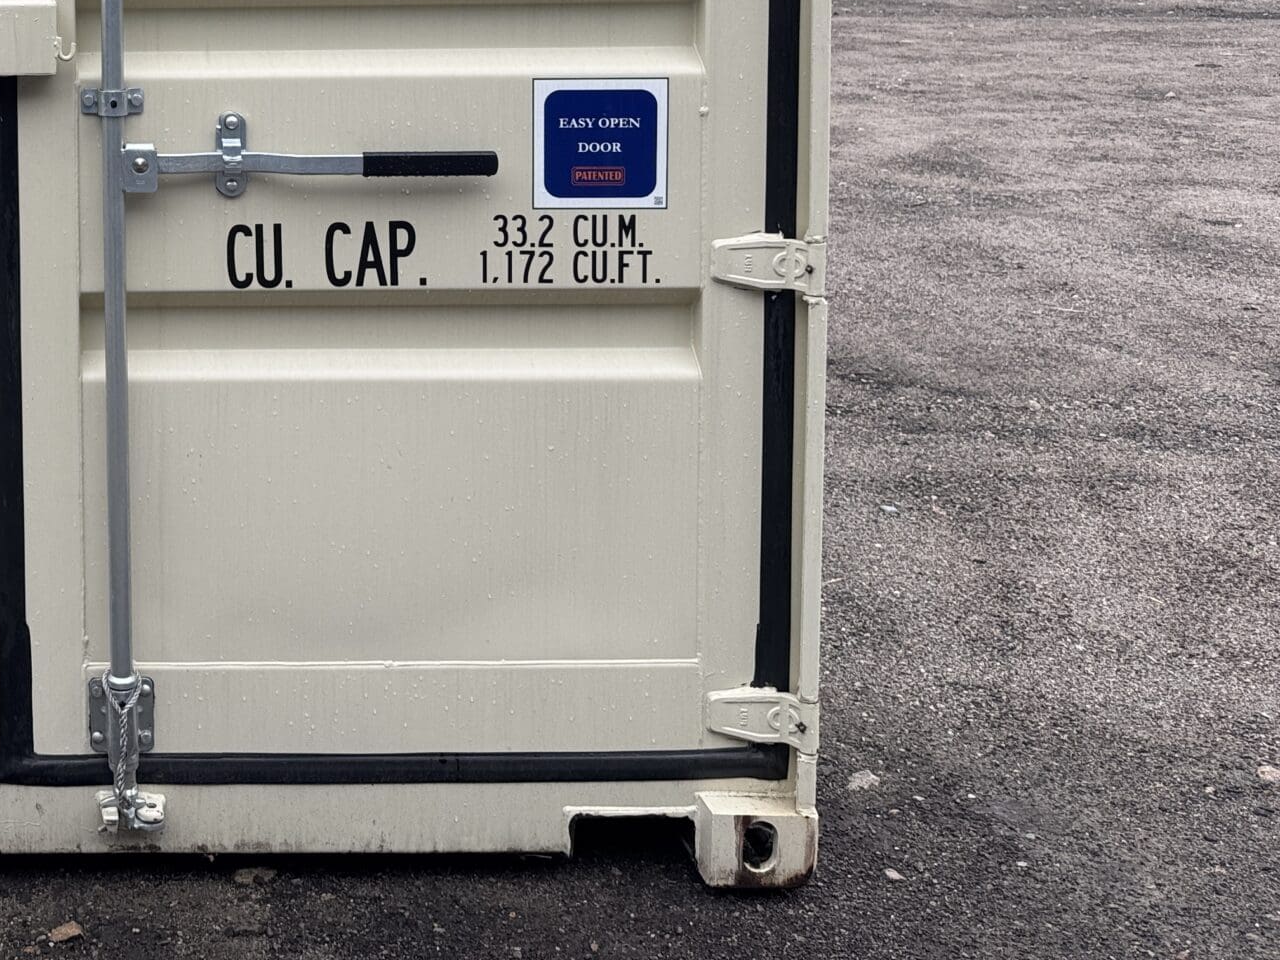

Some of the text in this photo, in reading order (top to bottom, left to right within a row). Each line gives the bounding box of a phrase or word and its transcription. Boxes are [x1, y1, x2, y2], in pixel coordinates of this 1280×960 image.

[558, 117, 641, 128] EASY OPEN
[577, 142, 622, 153] DOOR
[575, 170, 622, 181] PATENTED
[493, 214, 644, 248] 33.2 CU.M.
[226, 220, 427, 288] CU. CAP.
[480, 250, 661, 284] 1,172 CU.FT.
